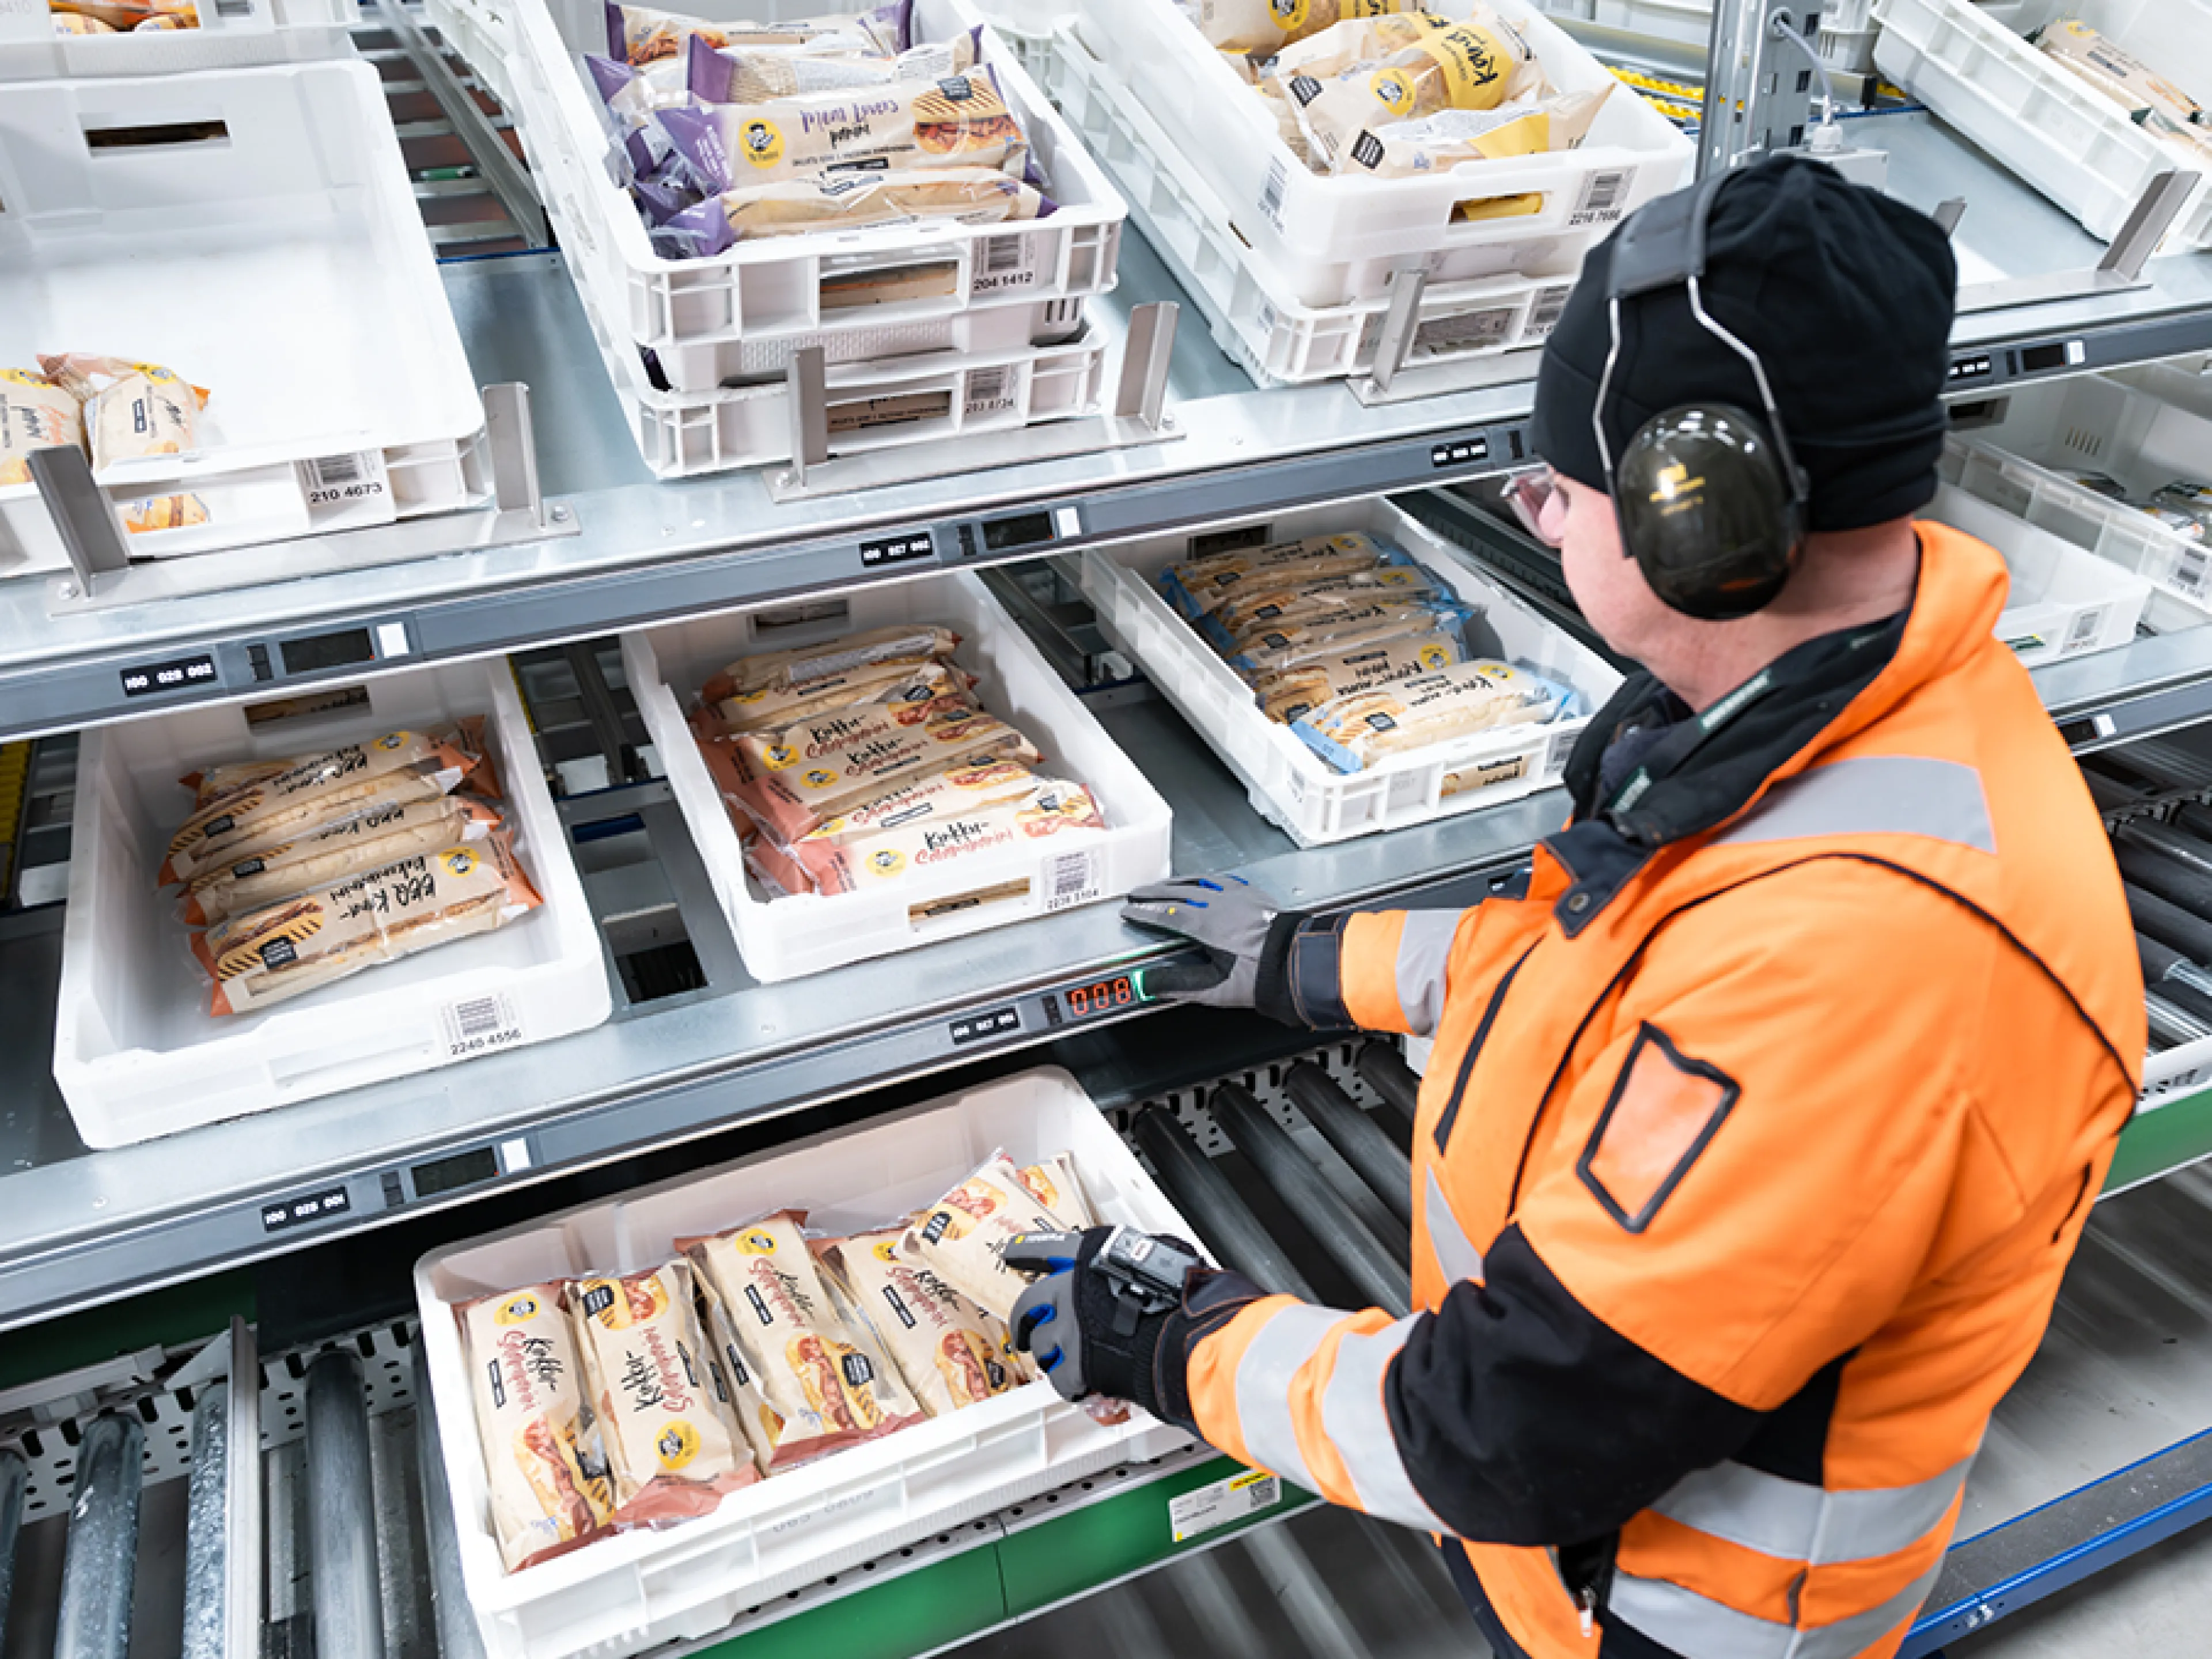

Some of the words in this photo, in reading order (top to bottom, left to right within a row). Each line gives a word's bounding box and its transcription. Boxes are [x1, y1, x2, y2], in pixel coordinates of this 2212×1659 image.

[974, 276, 999, 291] 204
[310, 488, 341, 503] 210
[1071, 976, 1132, 1016] 008
